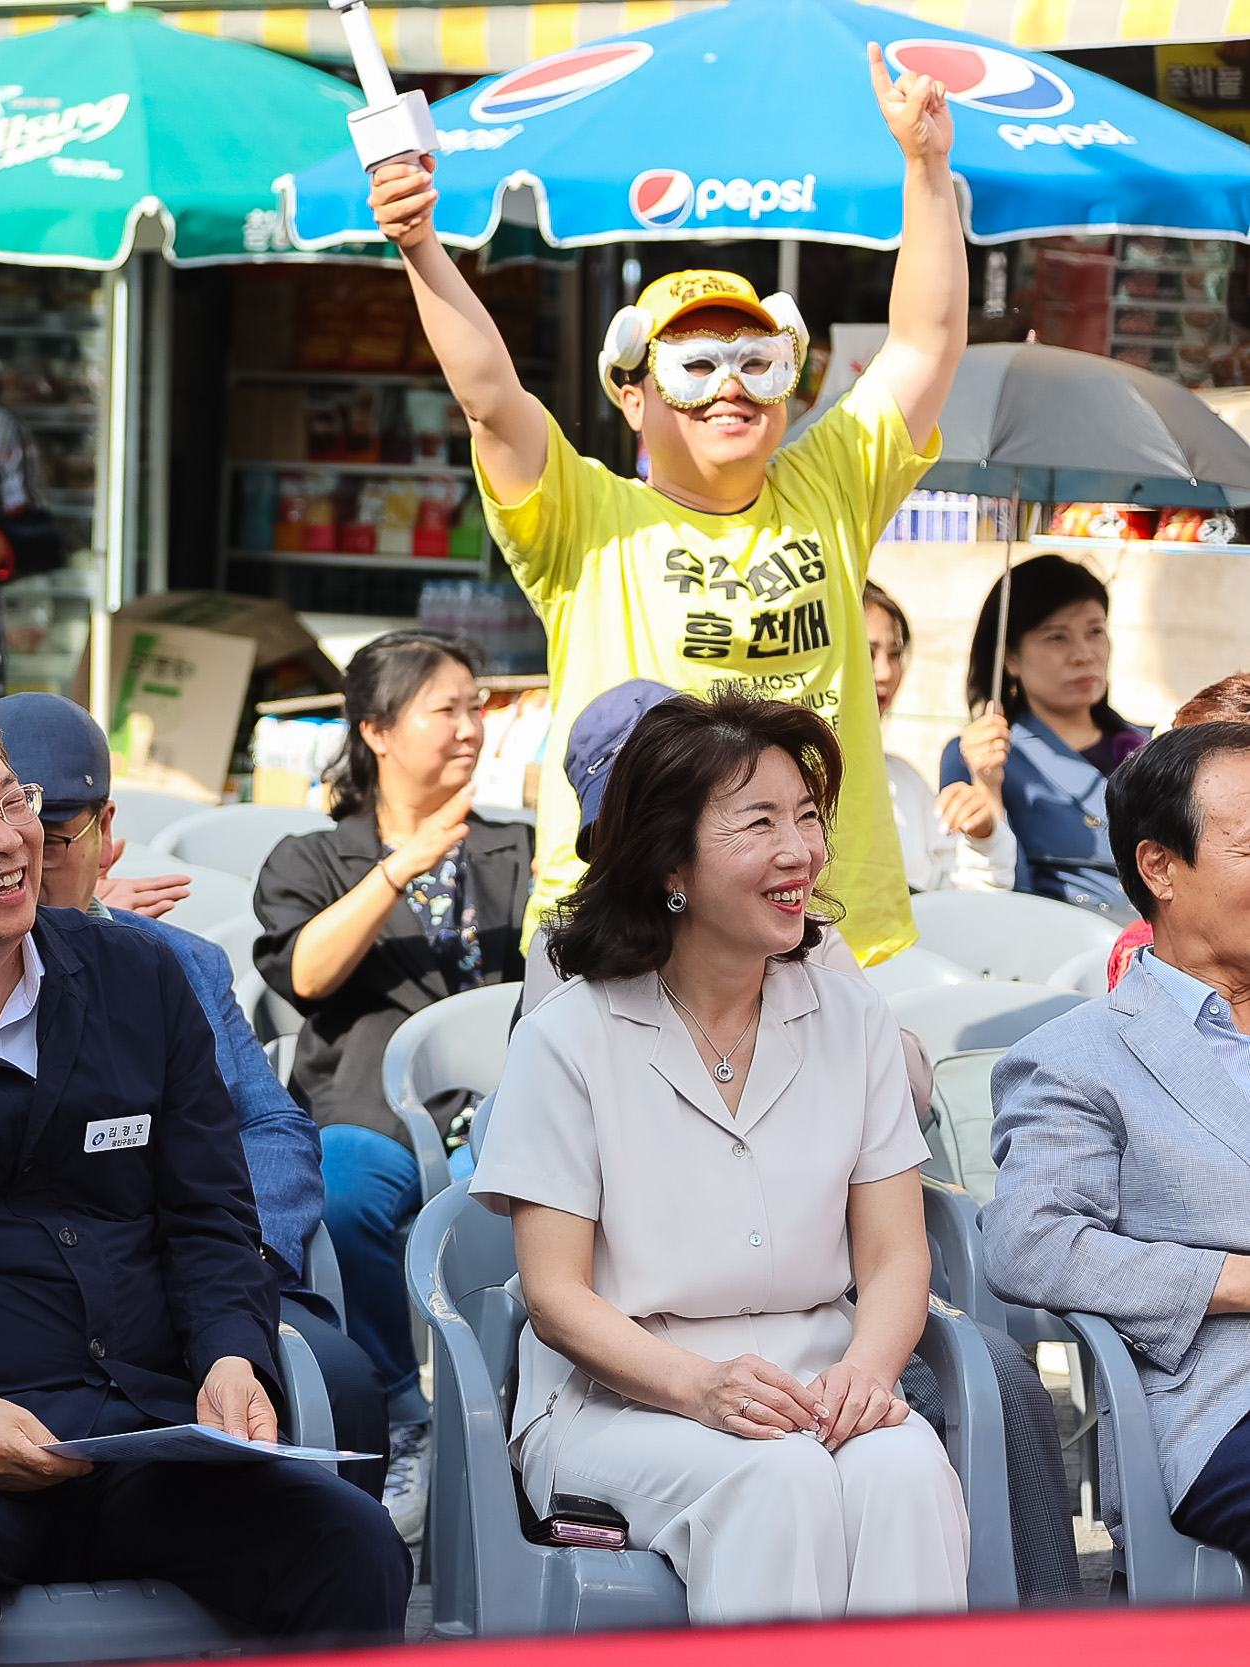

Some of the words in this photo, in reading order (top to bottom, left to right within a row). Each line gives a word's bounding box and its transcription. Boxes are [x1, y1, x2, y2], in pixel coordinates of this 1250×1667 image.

[997, 120, 1130, 151] pepsi
[695, 173, 816, 220] pepsi
[664, 539, 826, 602] 우주최강
[683, 610, 734, 659] 흥
[747, 600, 831, 658] 천재
